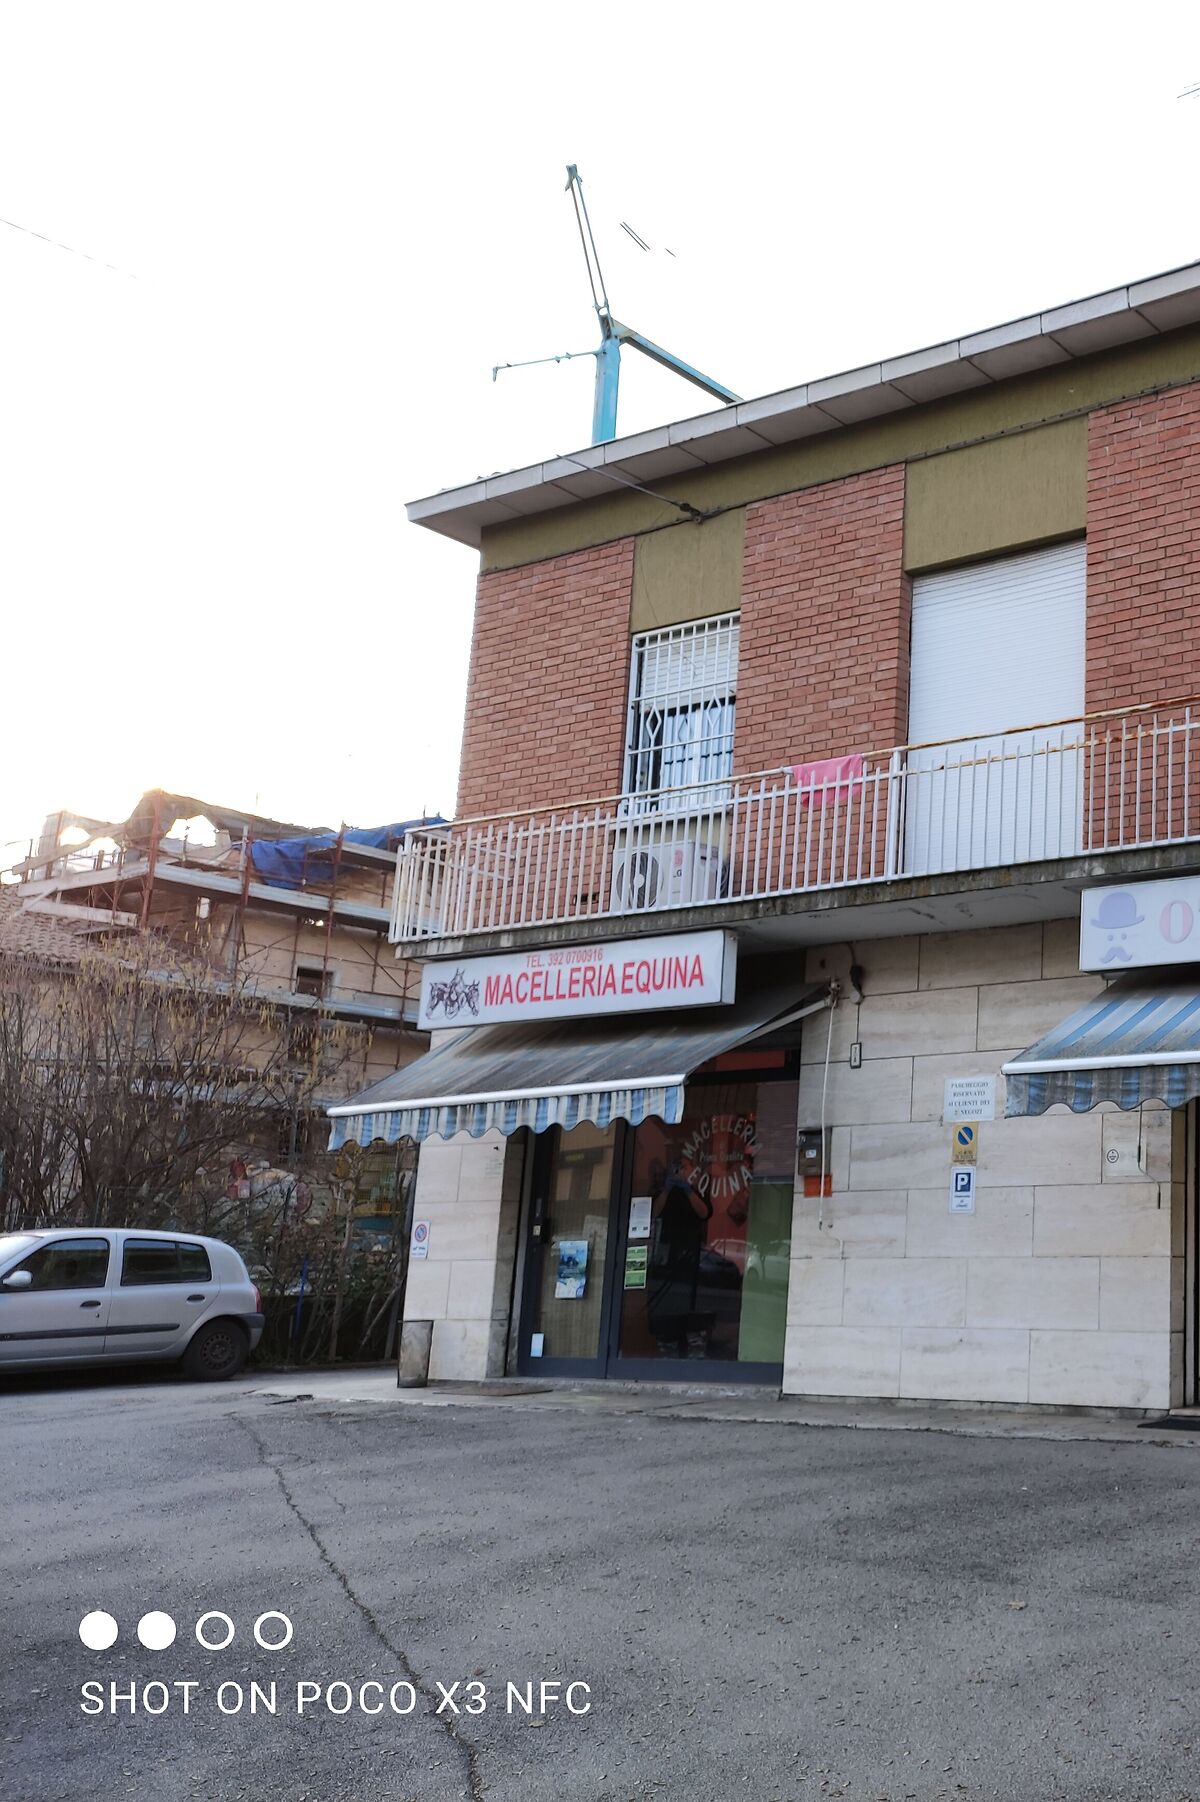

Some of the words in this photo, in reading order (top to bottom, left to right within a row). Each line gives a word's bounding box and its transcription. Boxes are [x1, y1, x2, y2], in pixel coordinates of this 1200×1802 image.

[526, 954, 545, 968] TEL.
[548, 951, 564, 967] 392
[484, 964, 617, 1007] MACELLERIA
[621, 954, 705, 995] EQUINA
[682, 1116, 764, 1160] MACELLERIA
[687, 1165, 754, 1199] EQUINA
